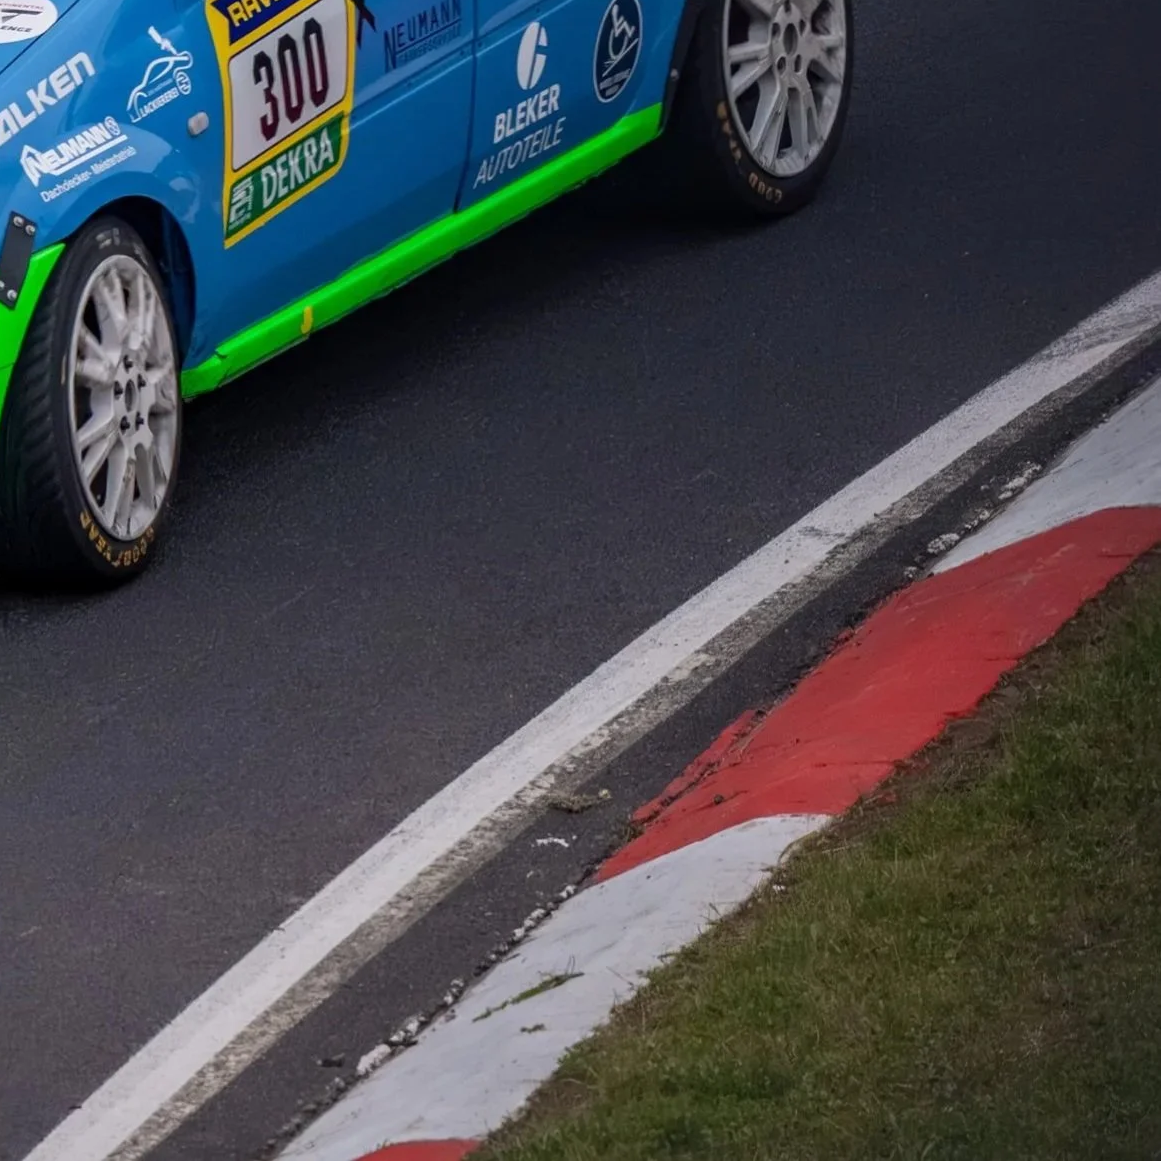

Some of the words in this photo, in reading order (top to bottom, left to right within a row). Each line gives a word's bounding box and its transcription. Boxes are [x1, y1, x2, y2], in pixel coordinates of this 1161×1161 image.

[253, 17, 329, 141] 300
[493, 84, 561, 143] BLEKER
[20, 122, 112, 187] NEUMANN
[260, 127, 335, 209] DEKRA
[473, 116, 566, 189] AUTOTEILE
